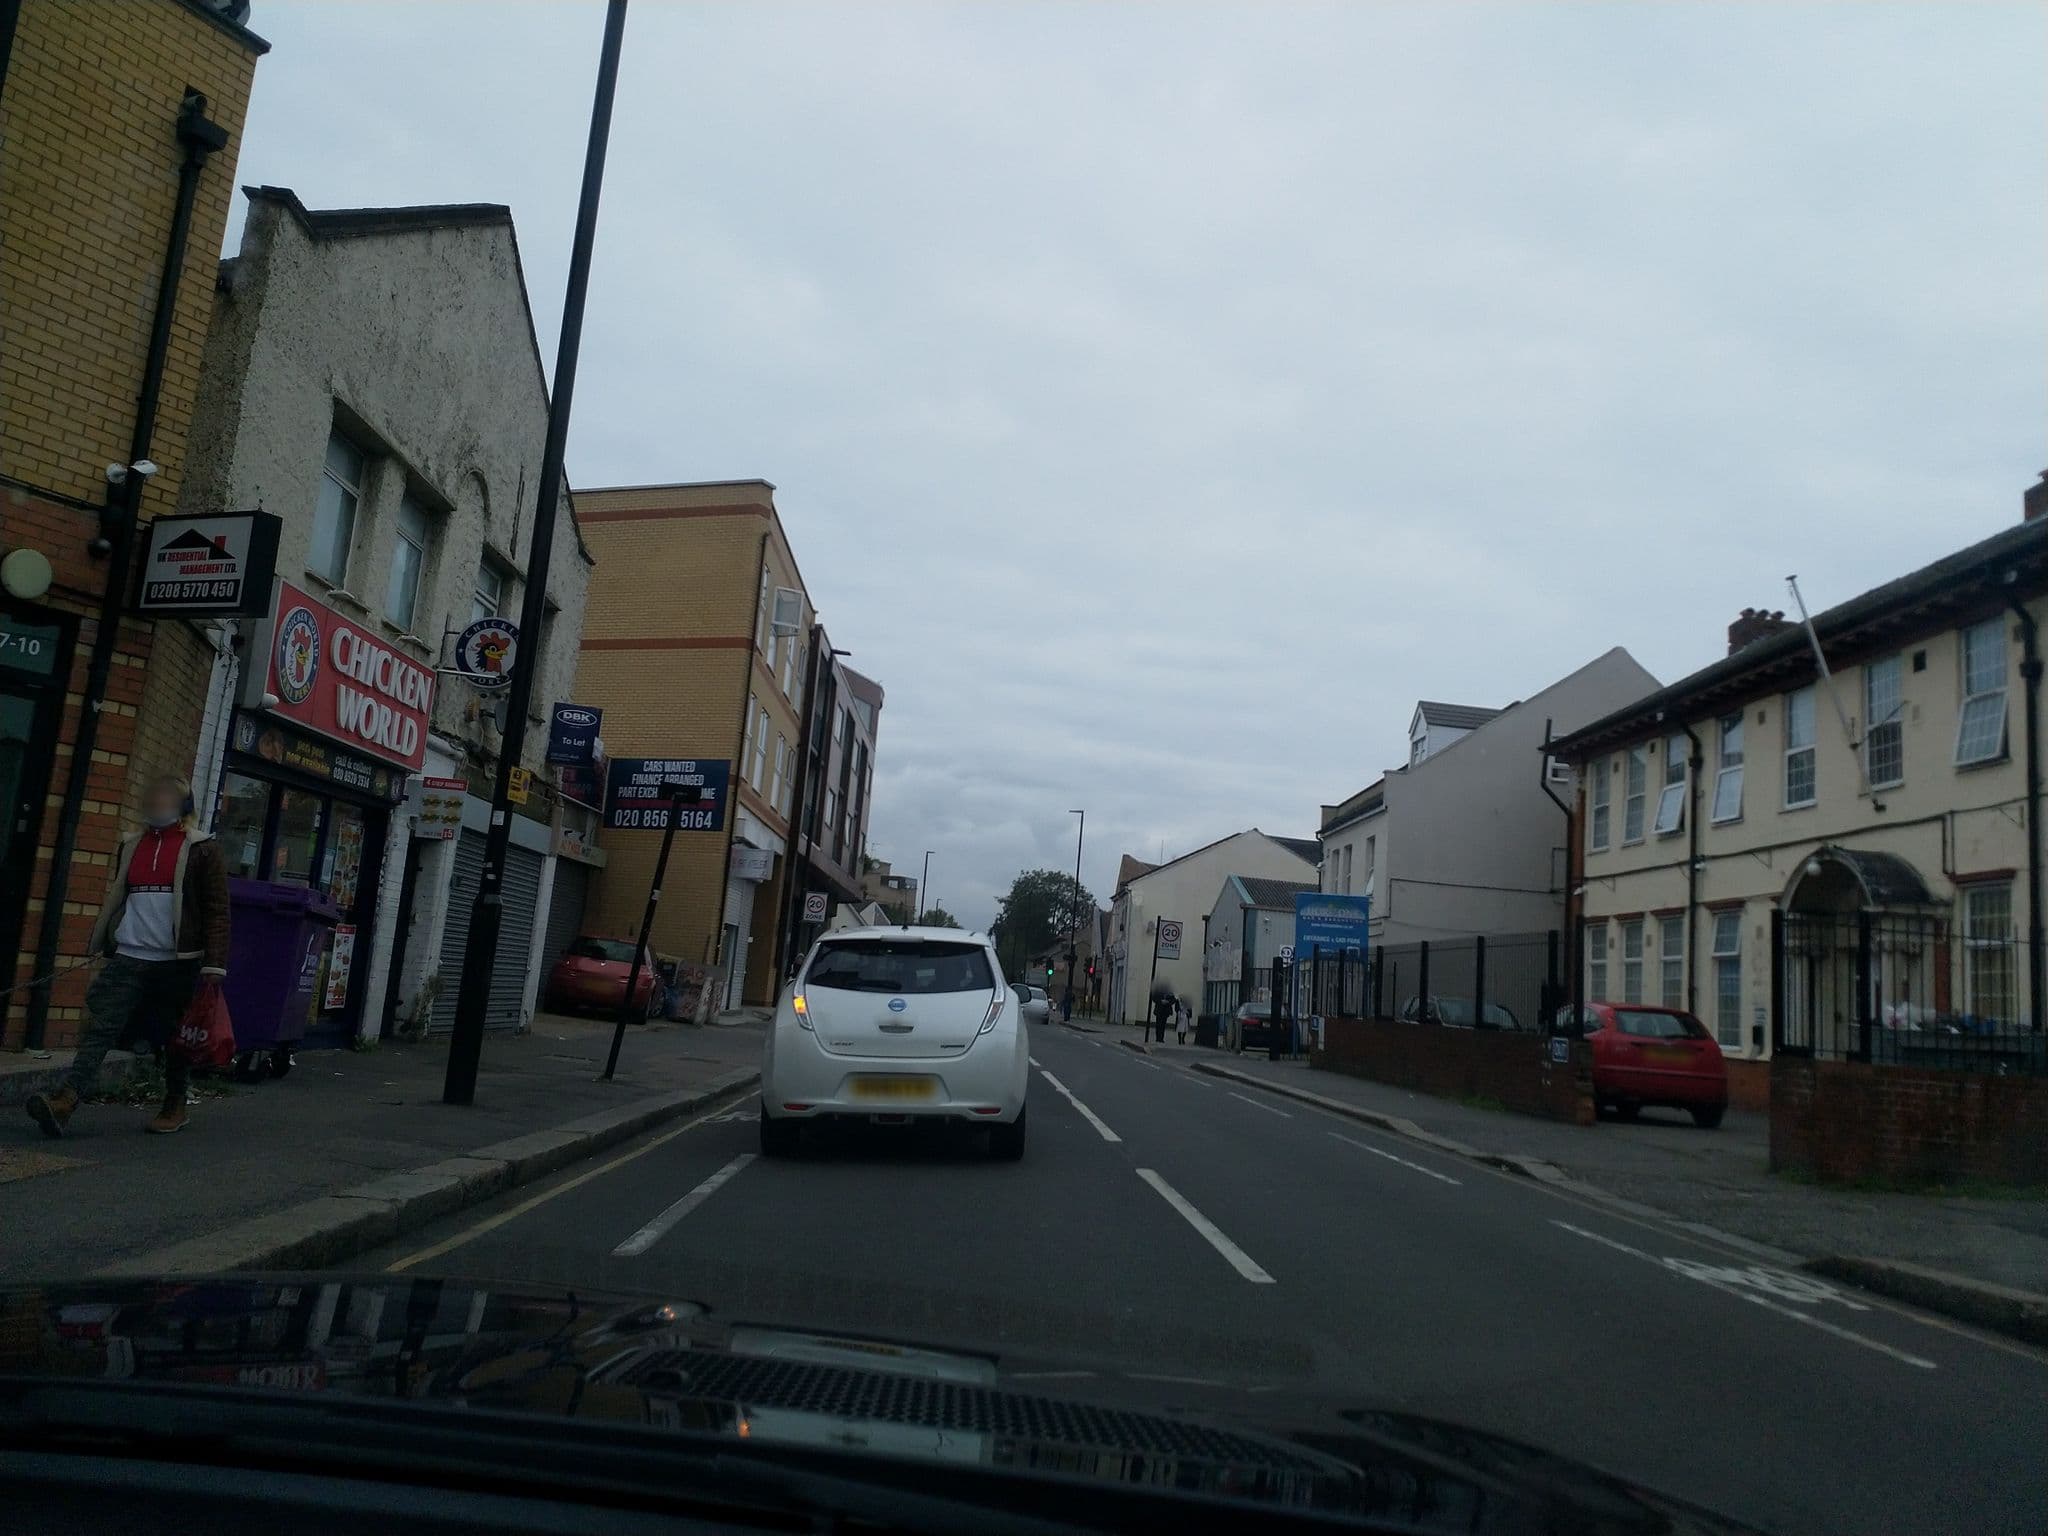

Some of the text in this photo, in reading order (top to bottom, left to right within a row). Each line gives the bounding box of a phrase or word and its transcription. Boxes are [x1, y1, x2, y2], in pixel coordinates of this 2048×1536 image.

[167, 550, 209, 563] RESIDENTIAL
[179, 564, 223, 575] MANAGEMENT
[150, 581, 235, 598] 0208 5770 450
[284, 611, 310, 639] CHICKEN
[330, 627, 433, 715] CHICKEN
[336, 684, 419, 757] WORLD
[562, 711, 590, 722] DBK
[562, 737, 586, 746] To Let
[643, 761, 696, 773] CARS WANTED
[631, 773, 705, 786] FINANCE ARRANGED
[618, 787, 636, 798] PART
[614, 809, 712, 828] 020 856 5164
[809, 900, 822, 908] 20
[1165, 928, 1178, 937] 20
[1161, 941, 1178, 949] ZONE
